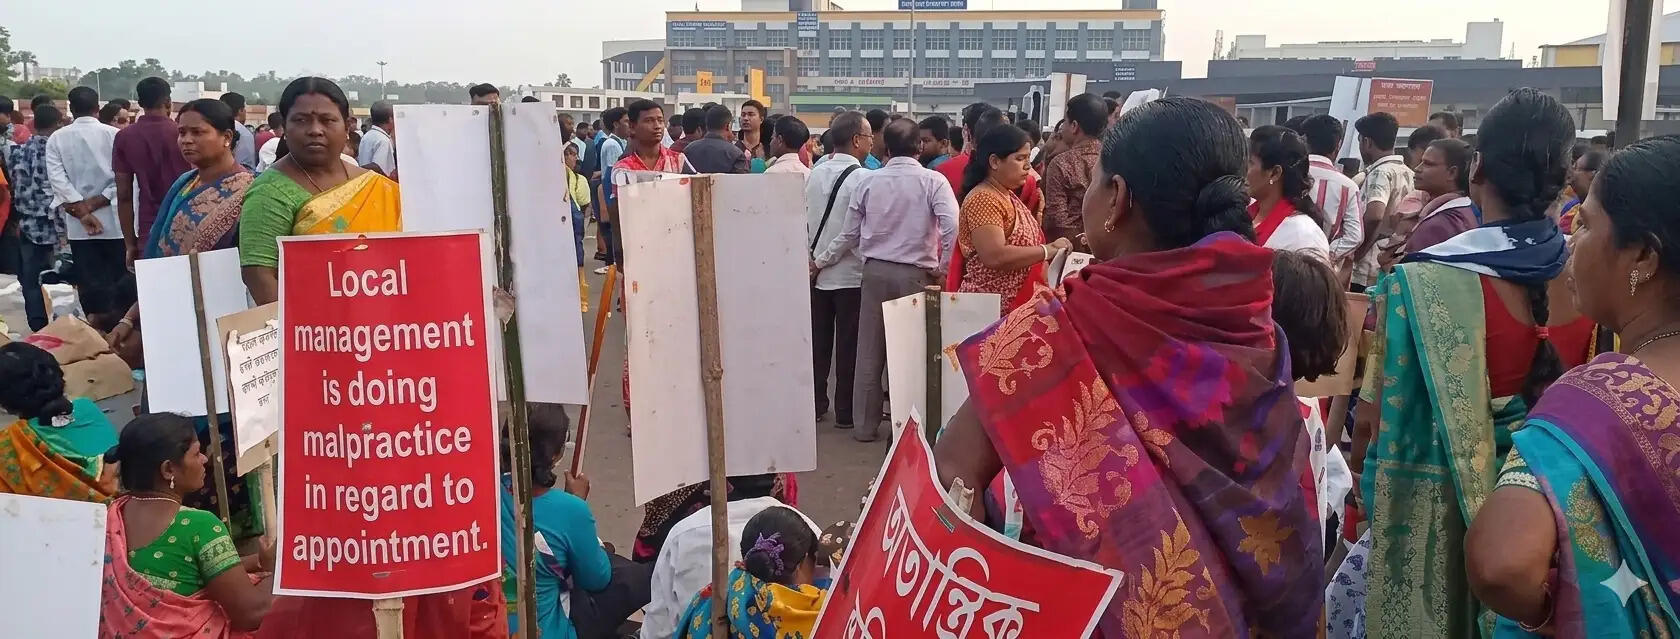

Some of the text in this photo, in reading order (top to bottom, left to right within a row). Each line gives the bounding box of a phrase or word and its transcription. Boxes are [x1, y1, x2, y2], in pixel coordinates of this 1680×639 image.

[328, 260, 407, 297] Local
[295, 312, 474, 362] management
[323, 370, 340, 405] is
[349, 370, 436, 412] doing
[304, 421, 471, 467] malpractice
[306, 473, 473, 521] in regard to
[293, 520, 487, 571] appointment.
